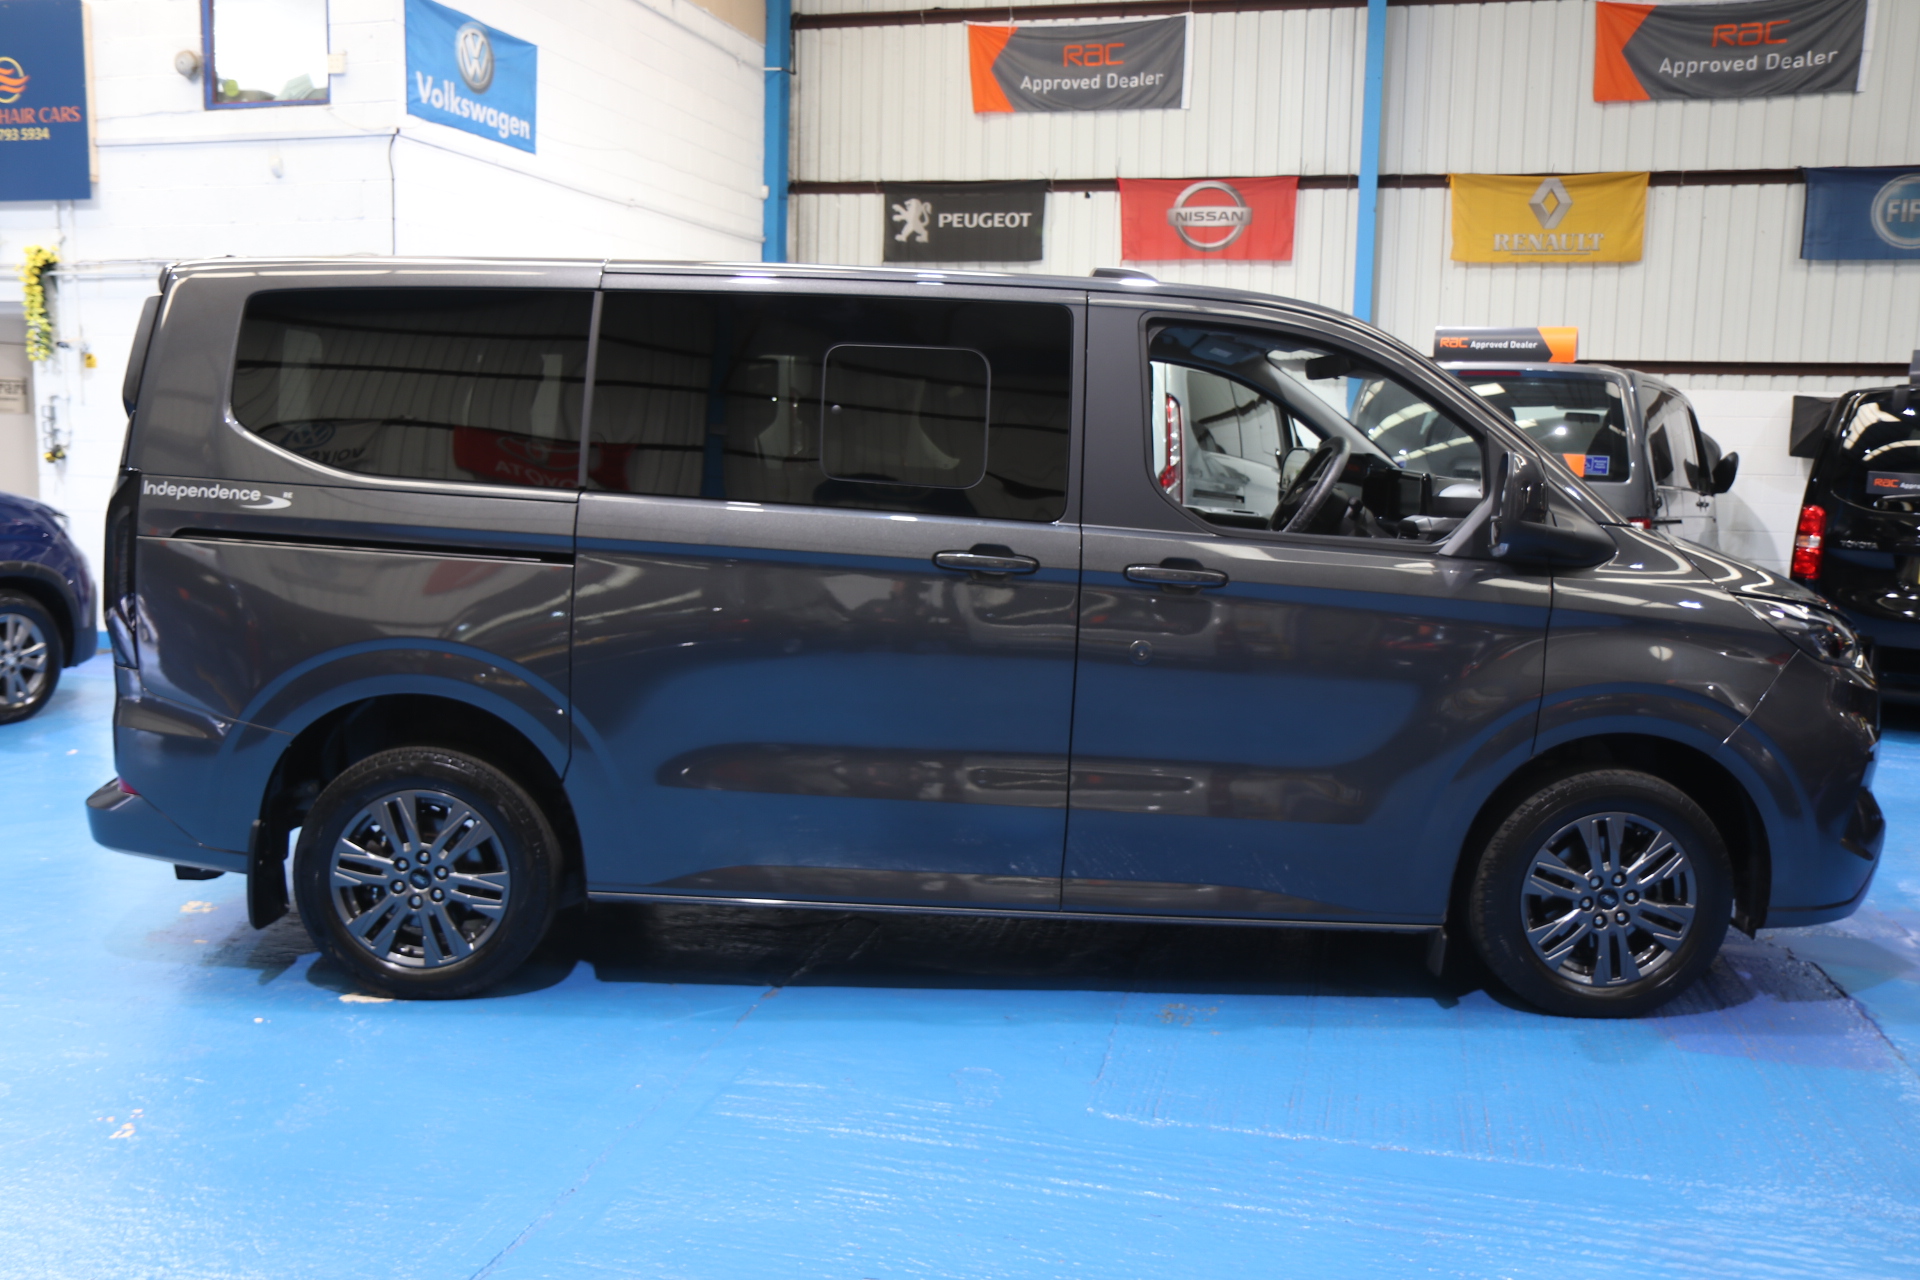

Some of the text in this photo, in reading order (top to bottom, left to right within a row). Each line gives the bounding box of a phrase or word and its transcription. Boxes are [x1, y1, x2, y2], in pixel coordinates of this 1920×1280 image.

[1658, 50, 1840, 78] Approved Dealer
[1019, 71, 1165, 95] Approved Dealer
[415, 69, 532, 140] Volkswagen
[38, 105, 82, 123] CARS
[20, 126, 50, 141] 5934
[938, 212, 1032, 228] PEUGEOT
[1174, 210, 1245, 223] NISSAN
[1492, 232, 1605, 252] RENAULT
[1469, 340, 1509, 350] Approved
[1509, 340, 1538, 349] Dealer
[143, 479, 262, 502] Independence
[1840, 540, 1879, 550] TOYOTA
